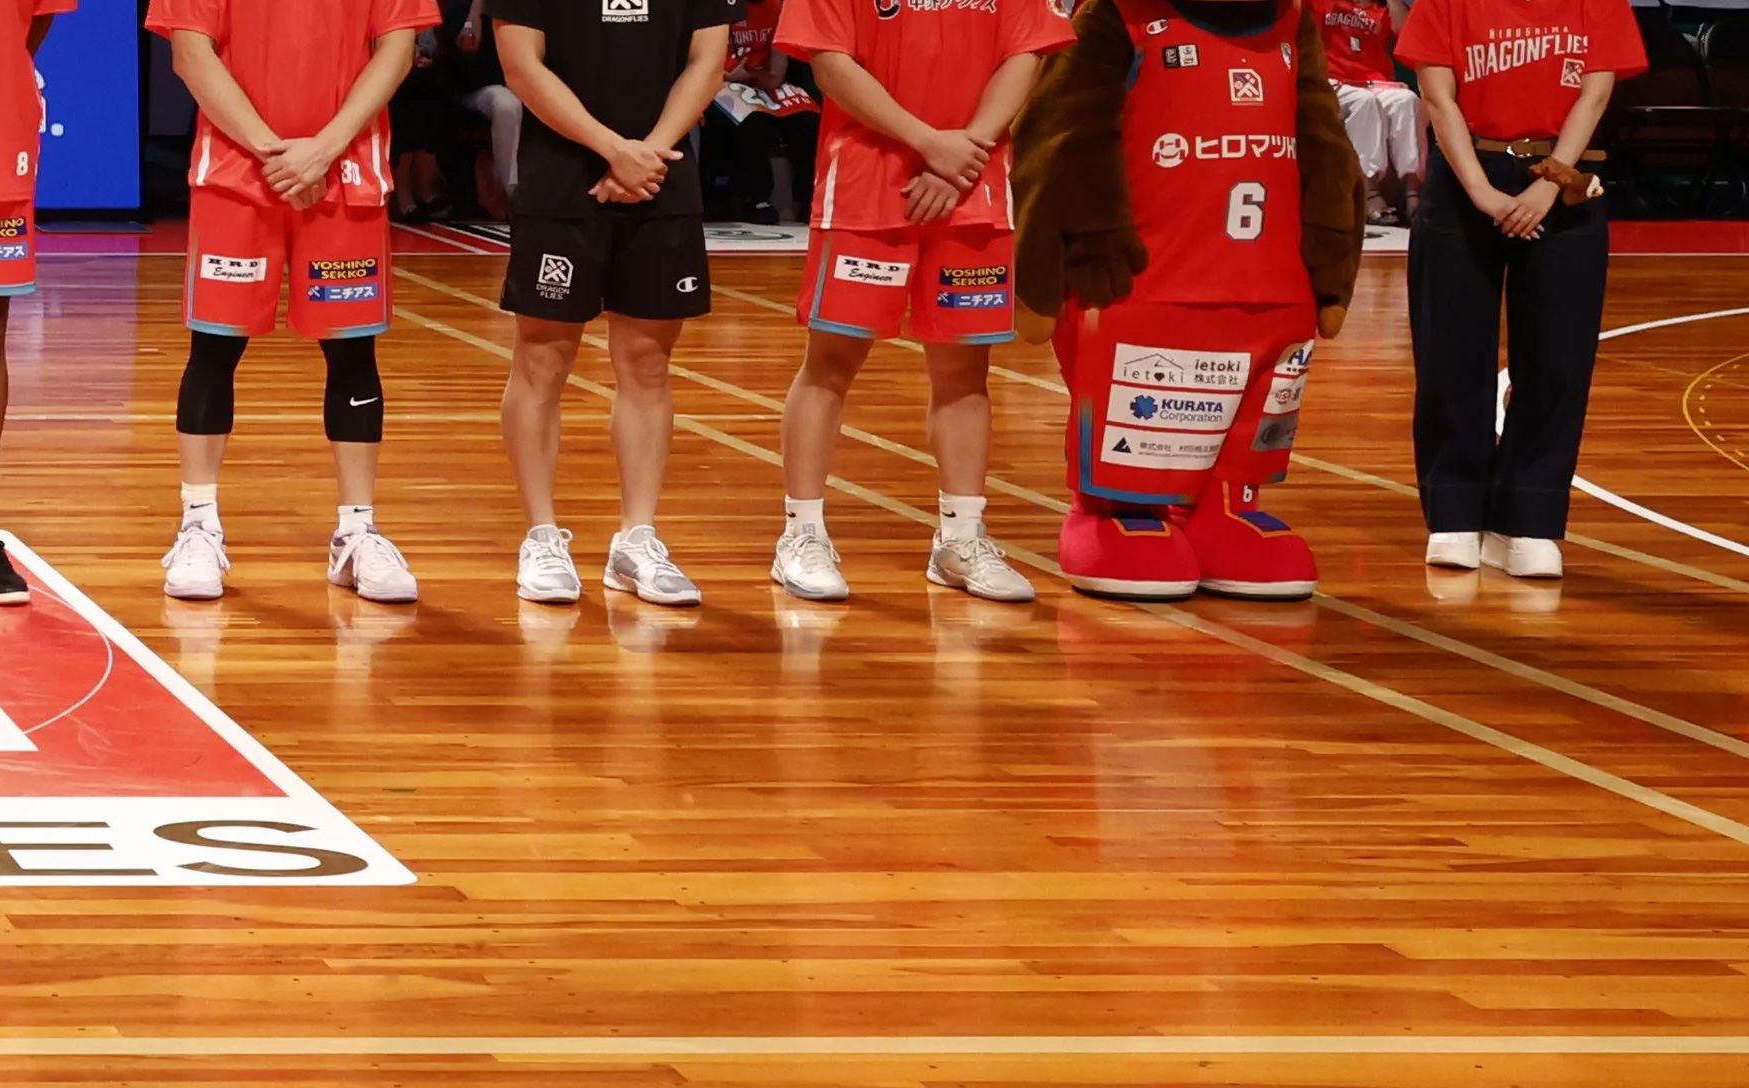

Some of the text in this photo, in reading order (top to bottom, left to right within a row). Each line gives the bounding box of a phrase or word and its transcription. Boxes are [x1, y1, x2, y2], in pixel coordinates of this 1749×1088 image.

[602, 15, 649, 23] DRAGONFLIES
[1489, 26, 1570, 39] HIROSHIMA
[1195, 134, 1297, 161] ヒロマツH
[15, 151, 29, 177] 8
[1225, 180, 1268, 242] 6
[311, 258, 376, 270] YOSHINO
[320, 269, 367, 279] SEKKO
[942, 266, 1007, 278] YOSHINO
[952, 276, 998, 287] SEKKO
[329, 286, 375, 300] ニチアス
[536, 284, 570, 295] DRAGON
[539, 291, 564, 301] FLIES
[959, 293, 1004, 306] ニチアス
[1195, 358, 1241, 373] ietoki
[1193, 374, 1238, 386] 株式会社
[1161, 398, 1224, 413] KURATA
[1159, 409, 1223, 423] Corporation
